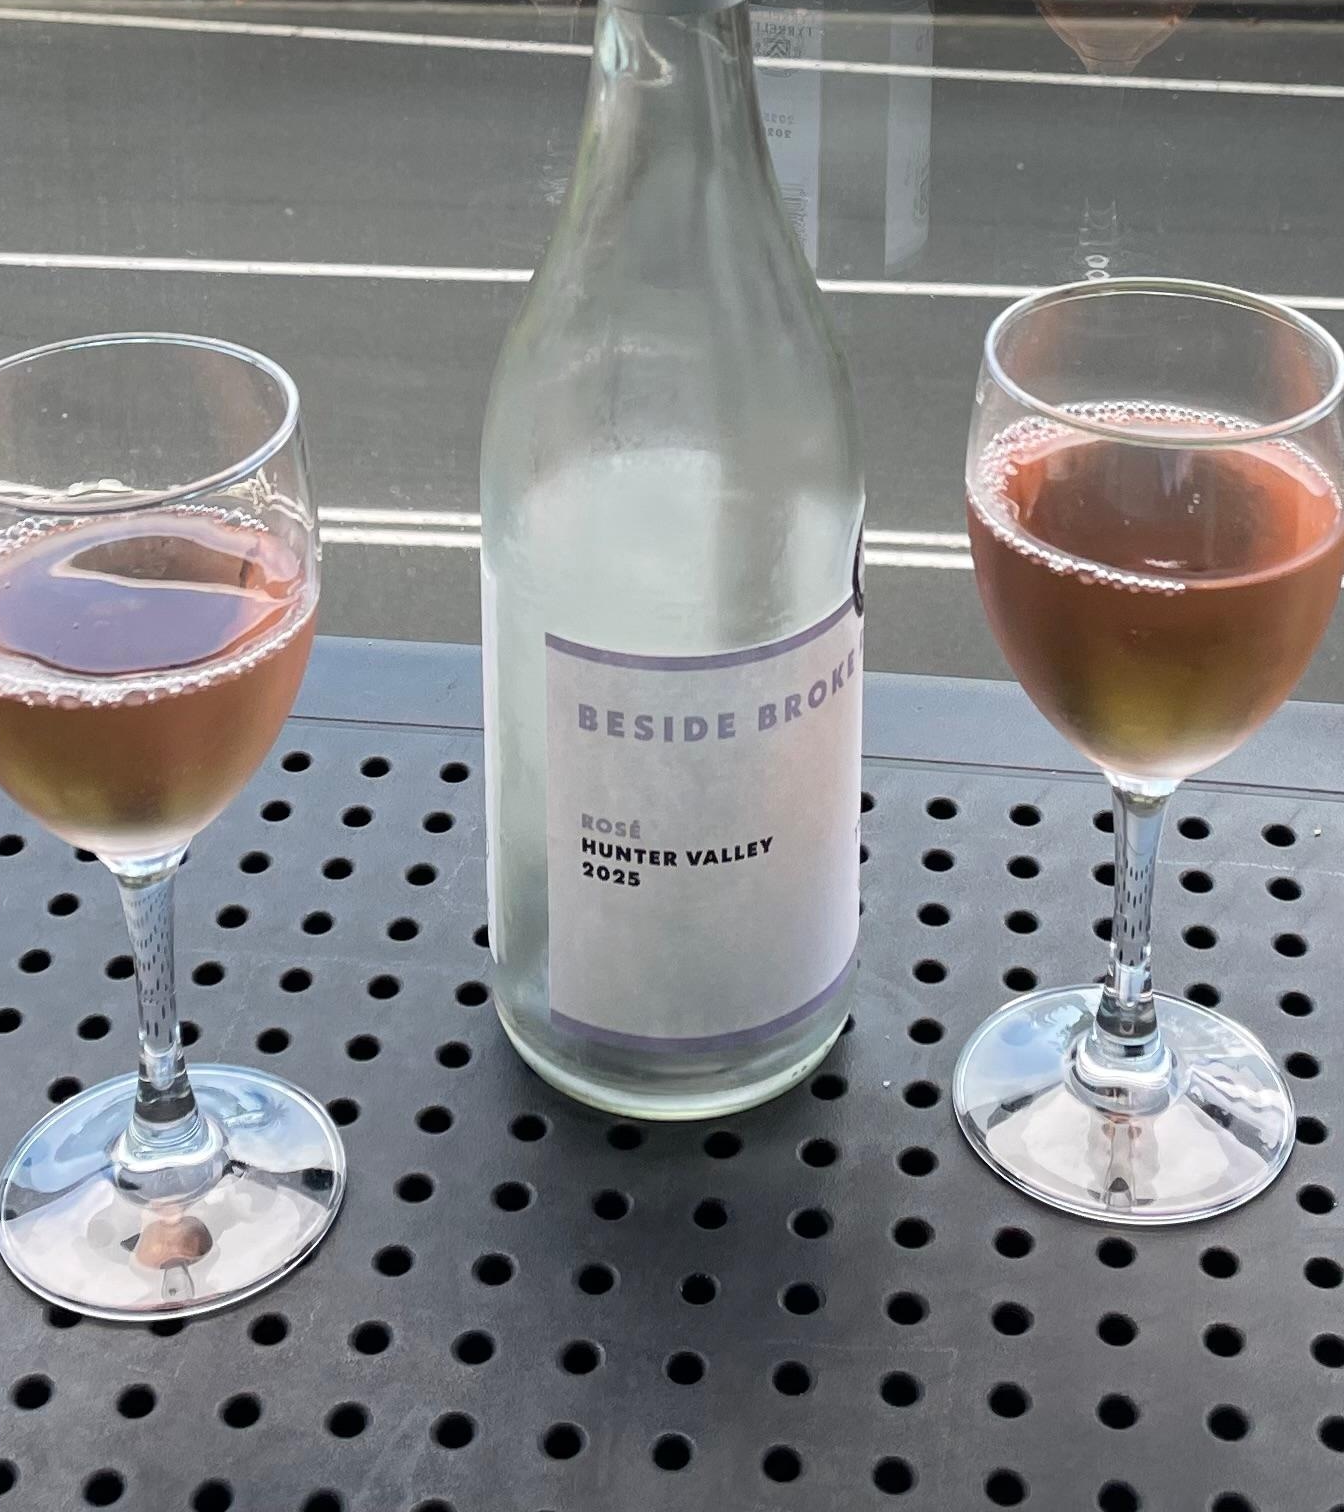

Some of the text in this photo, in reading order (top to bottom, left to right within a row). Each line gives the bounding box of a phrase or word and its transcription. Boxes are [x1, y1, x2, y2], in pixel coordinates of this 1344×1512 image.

[578, 648, 855, 743] BESIDE BROKE
[581, 813, 641, 839] ROSÉ
[582, 836, 773, 867] HUNTER VALLEY
[582, 861, 641, 887] 2025
